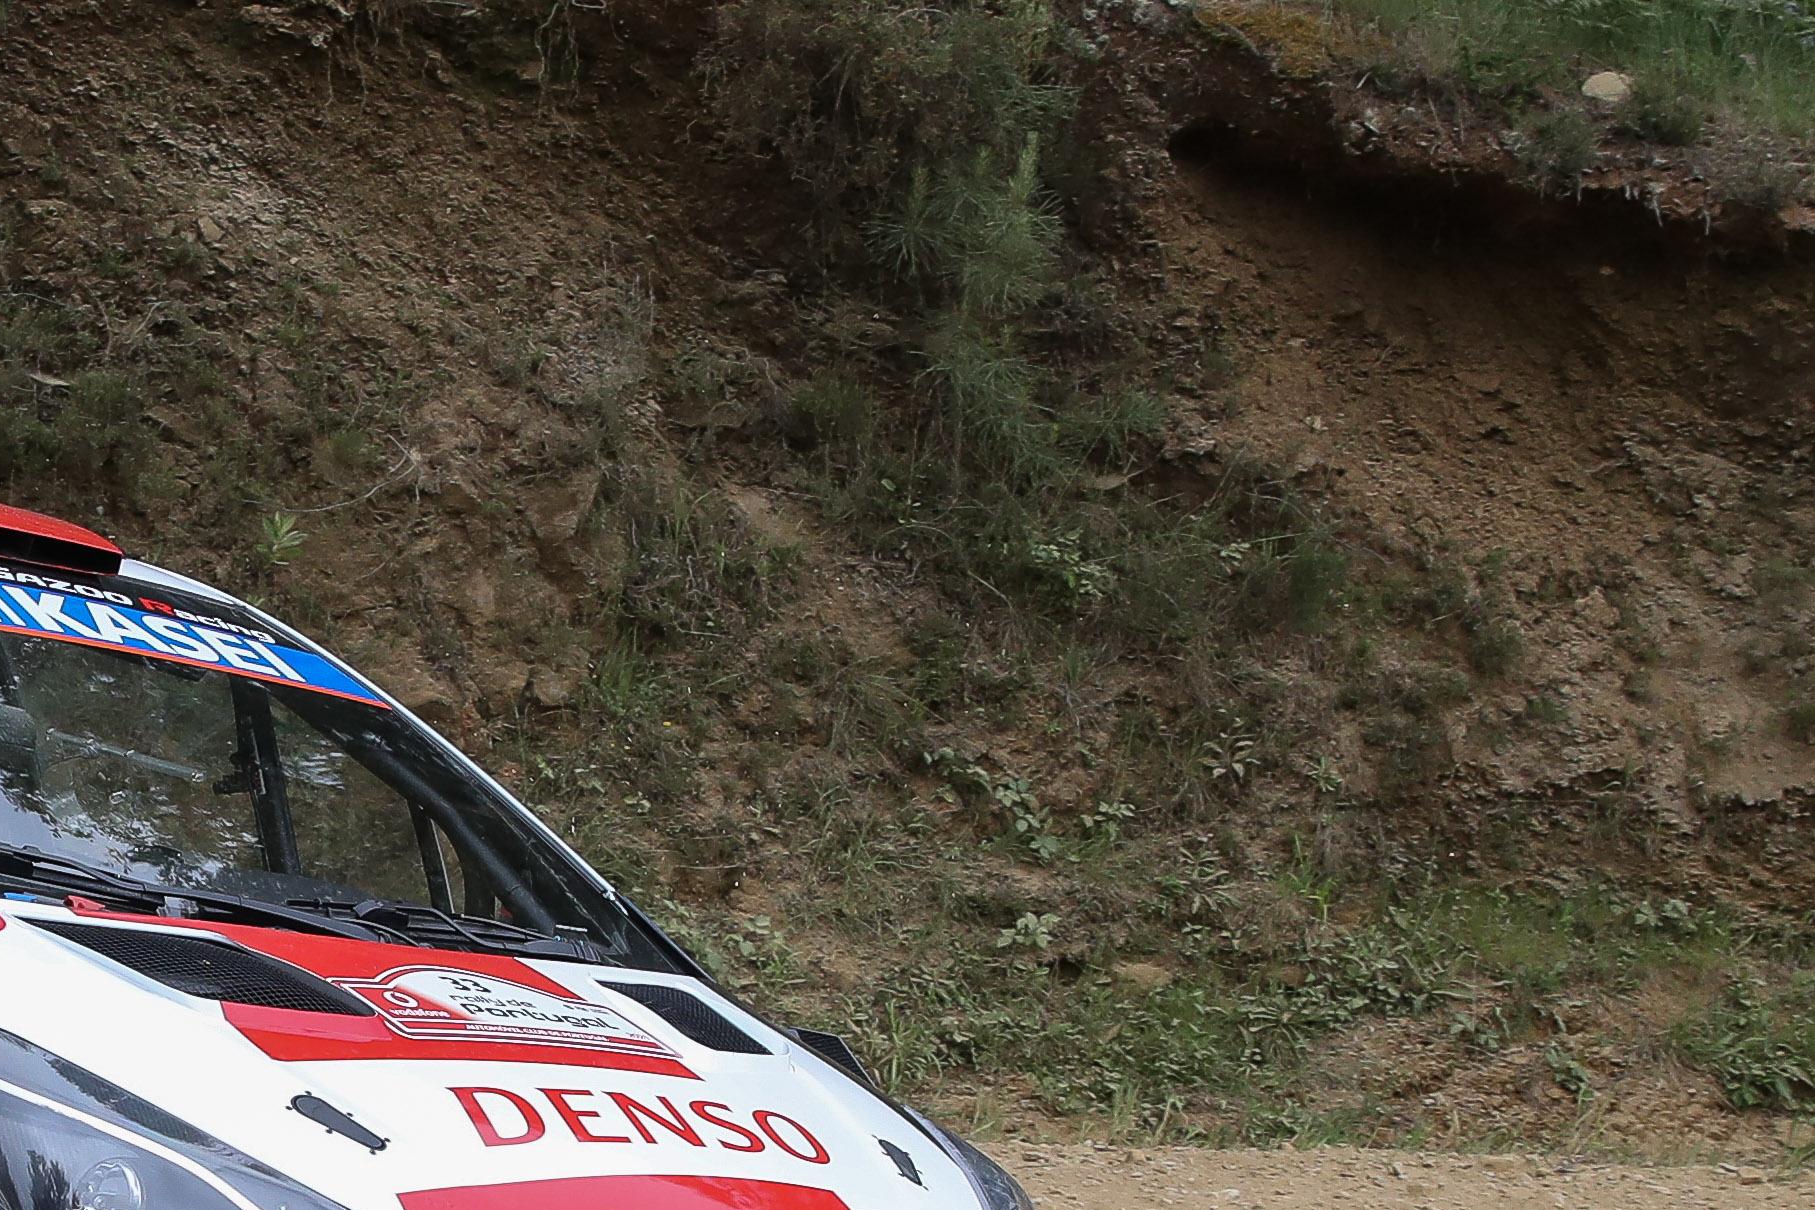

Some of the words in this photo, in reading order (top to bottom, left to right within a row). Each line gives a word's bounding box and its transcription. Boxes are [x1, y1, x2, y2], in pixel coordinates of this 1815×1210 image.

[138, 598, 278, 645] Racing
[438, 976, 492, 993] 33
[447, 1086, 831, 1165] DENSO
